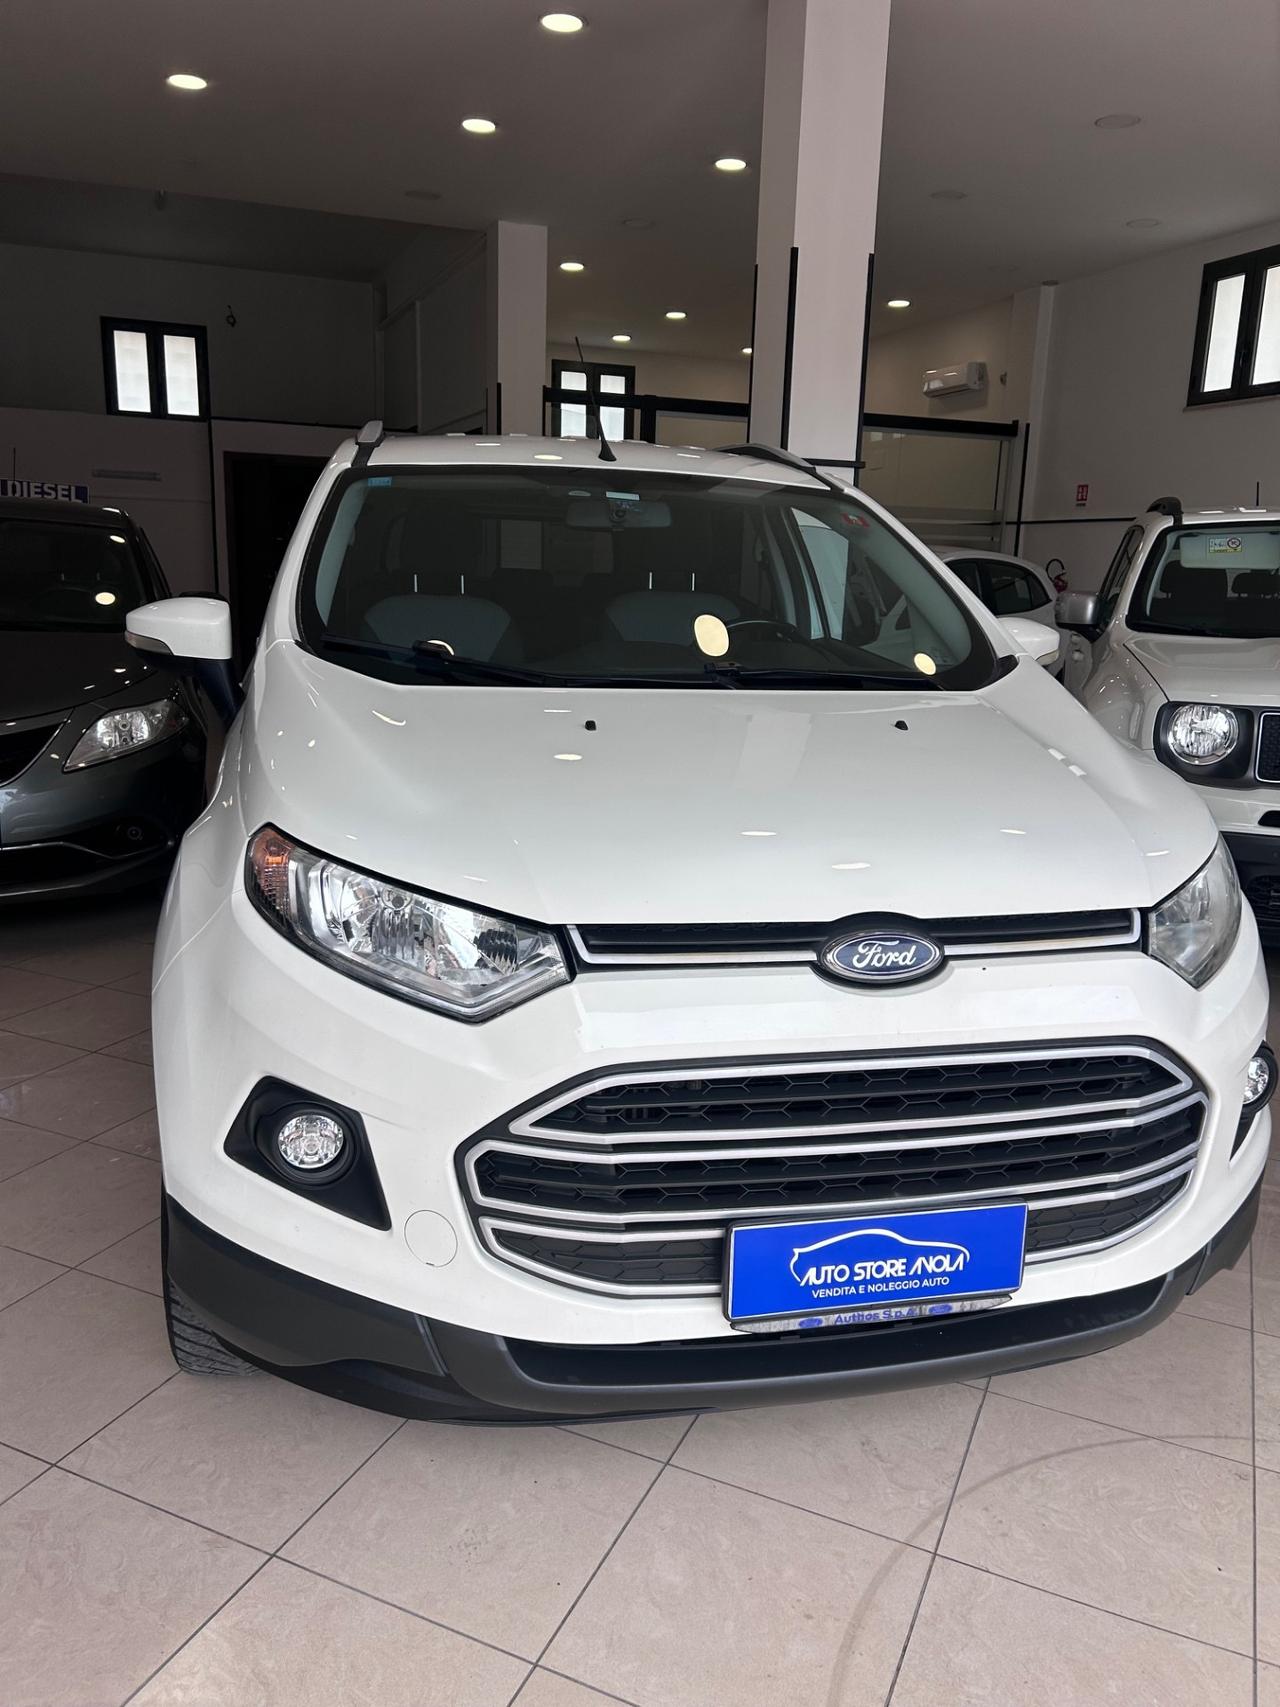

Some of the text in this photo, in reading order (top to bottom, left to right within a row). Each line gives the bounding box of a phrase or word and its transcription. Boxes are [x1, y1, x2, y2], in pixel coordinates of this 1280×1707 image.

[7, 480, 82, 503] DIESEL
[852, 940, 916, 968] Ford
[800, 1265, 849, 1286] AUTO
[853, 1258, 906, 1281] STORE
[811, 1276, 950, 1298] VENDITA E NOLEGGIO AUTO
[834, 1312, 880, 1325] Authos
